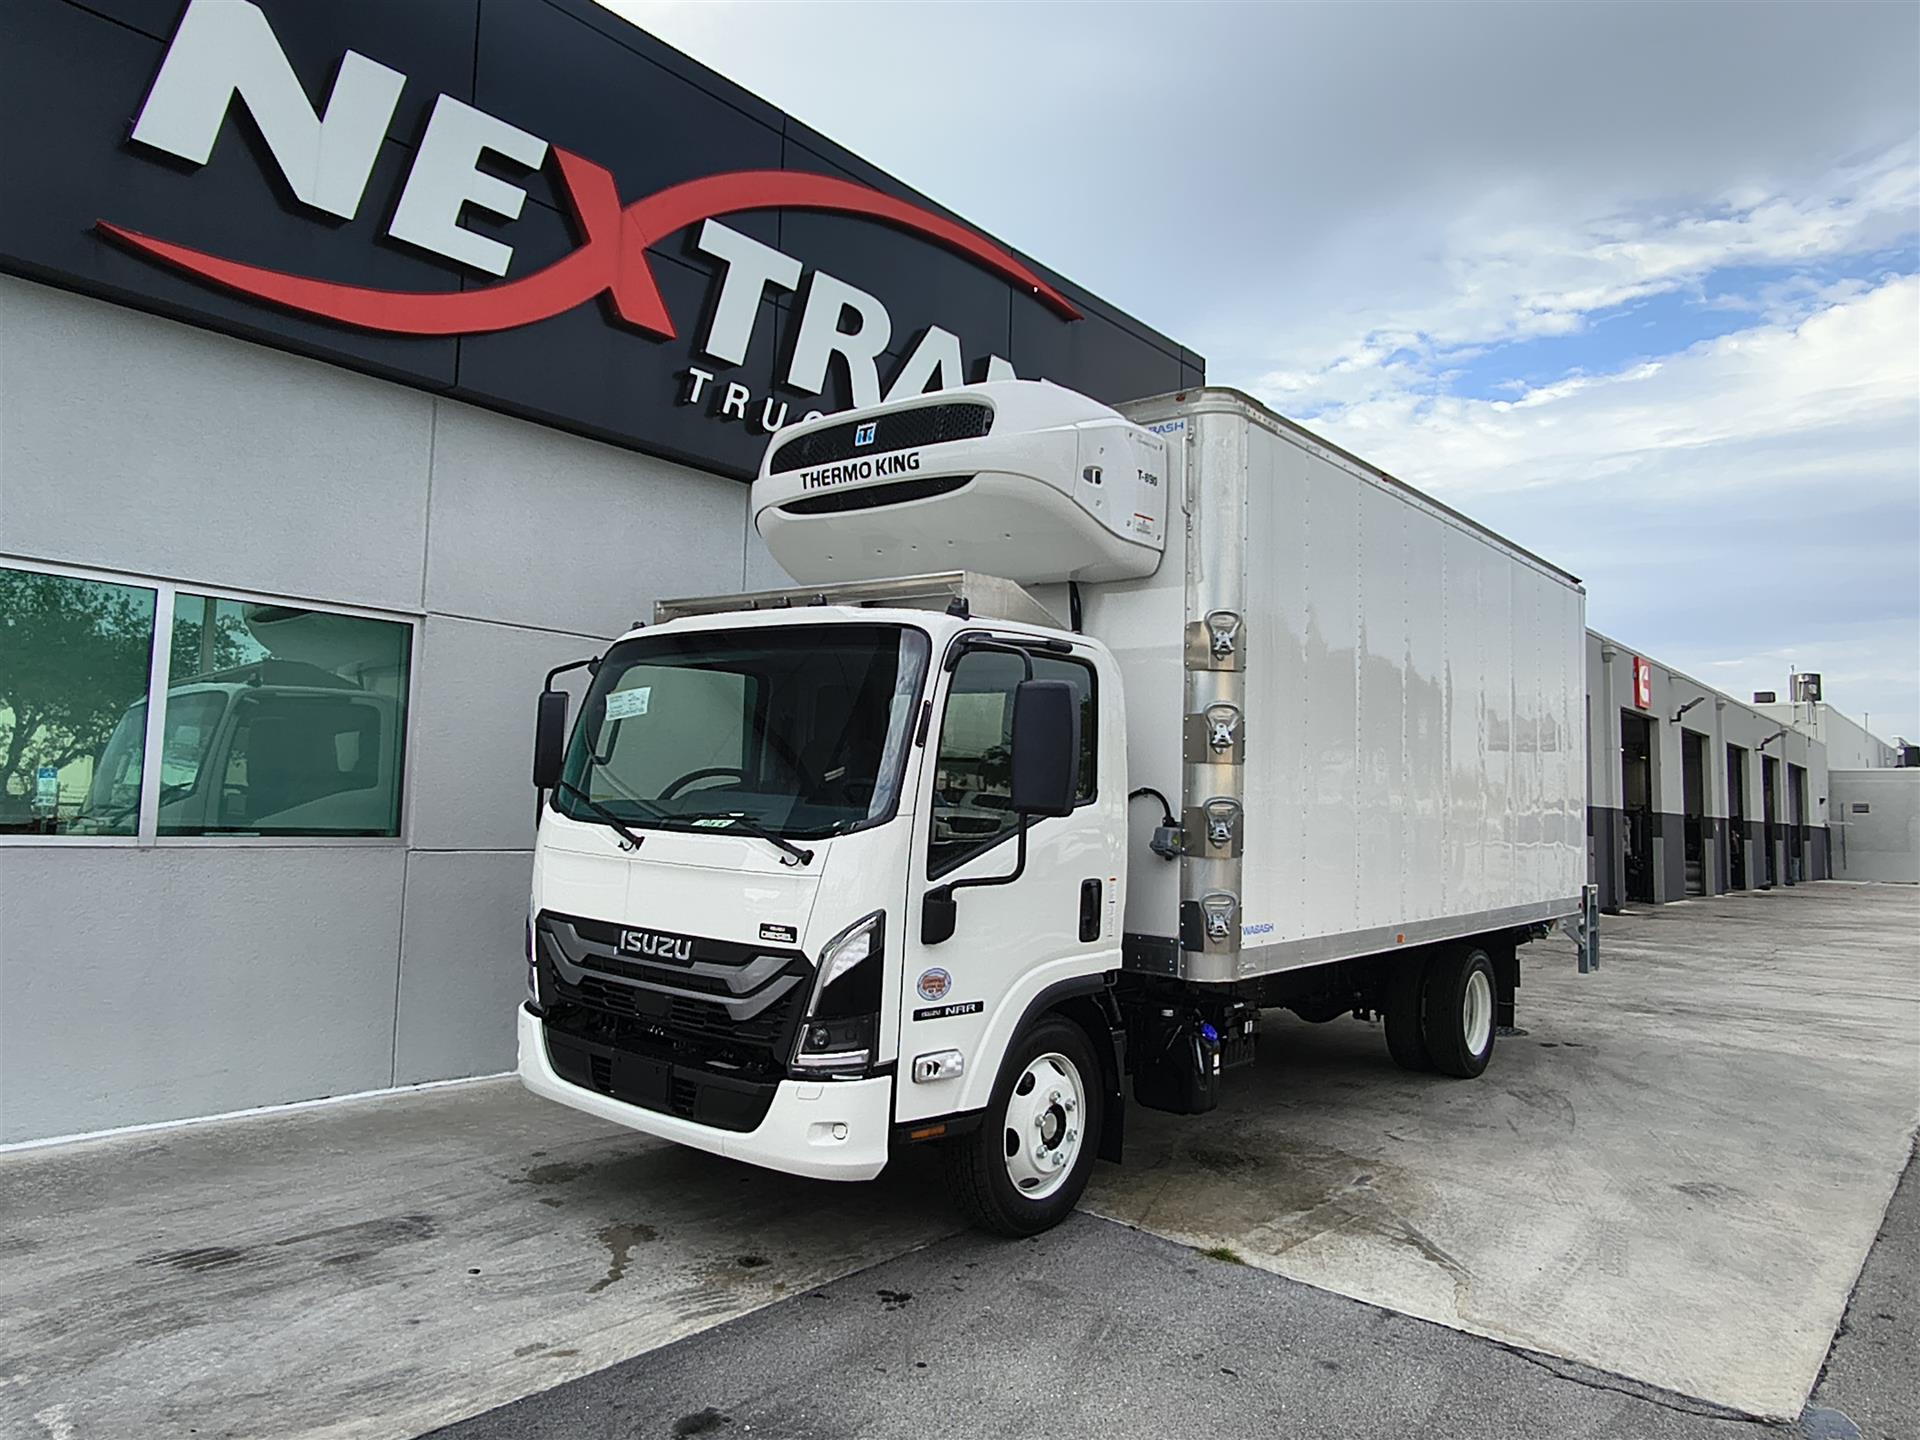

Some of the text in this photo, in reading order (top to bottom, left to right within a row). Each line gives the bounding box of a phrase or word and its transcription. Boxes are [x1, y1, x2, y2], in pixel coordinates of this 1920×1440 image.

[131, 0, 1066, 409] NEXTRA
[800, 452, 920, 490] THERMO KING
[620, 930, 692, 960] ISUZU
